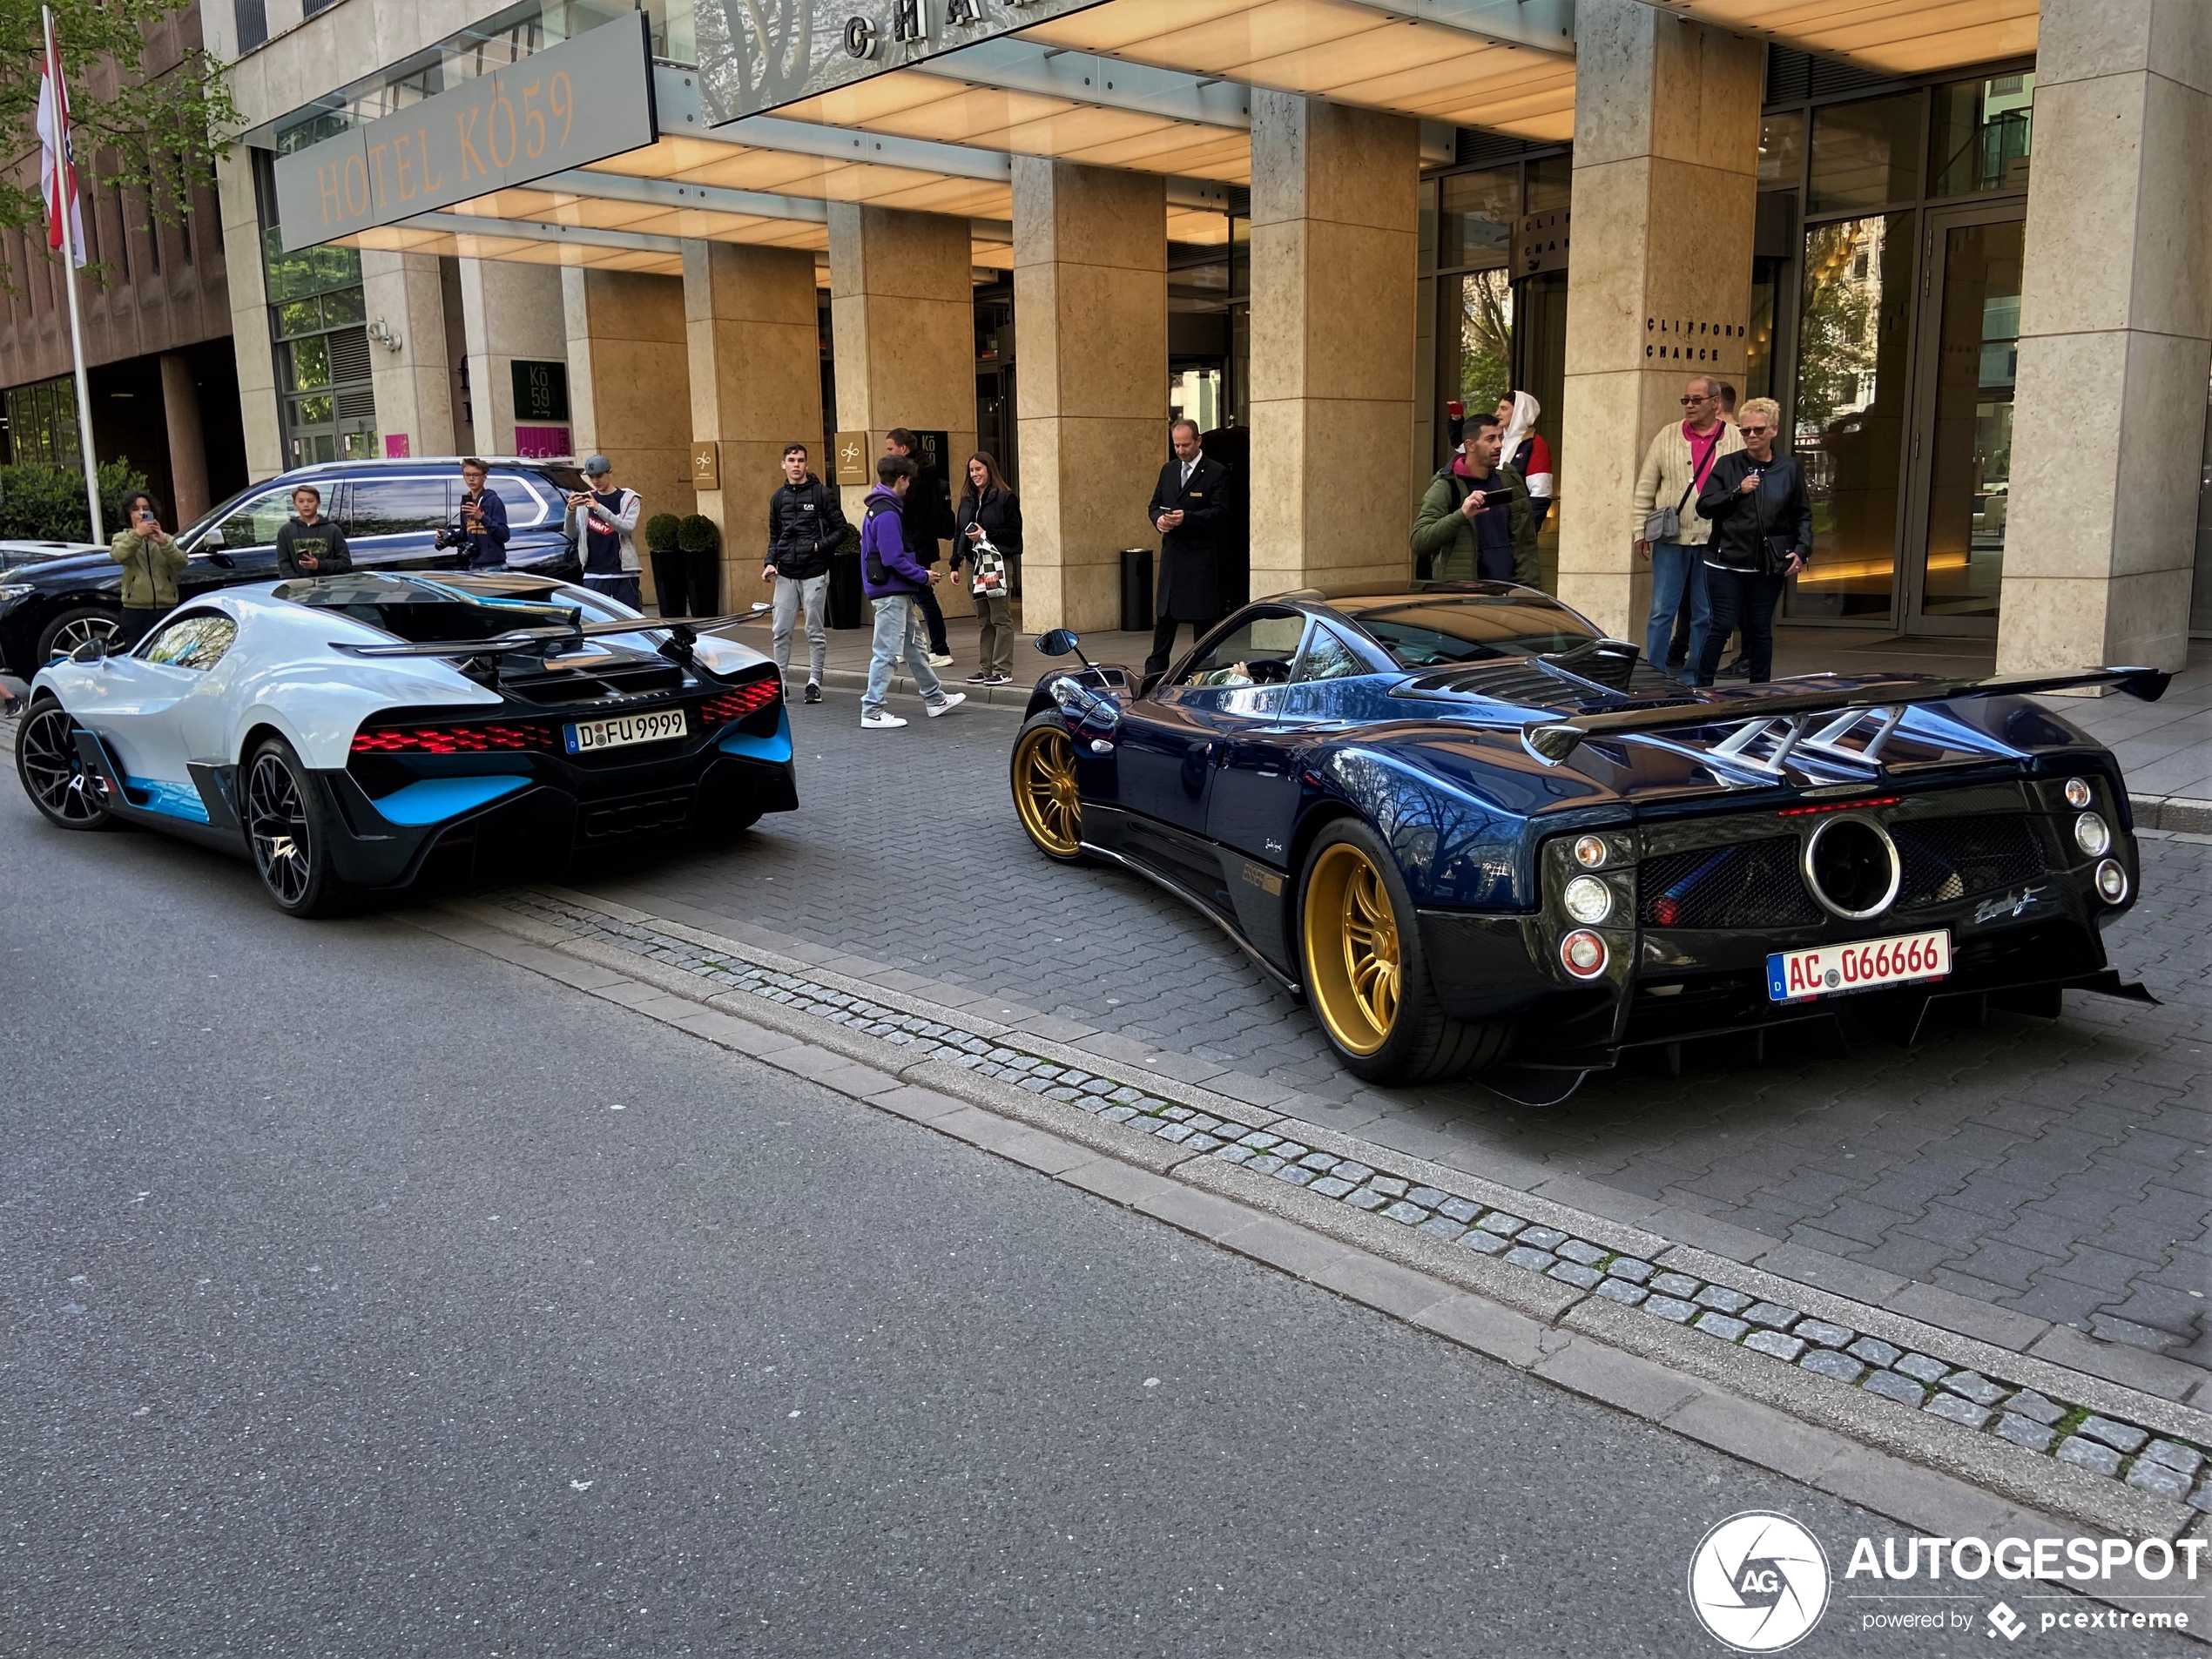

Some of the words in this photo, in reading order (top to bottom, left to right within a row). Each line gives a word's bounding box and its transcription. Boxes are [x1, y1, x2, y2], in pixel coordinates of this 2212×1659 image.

[317, 128, 442, 226] HOTEL
[455, 71, 574, 181] KÖ59
[1647, 318, 1744, 337] CLIFFORD
[1646, 345, 1718, 361] CHANCE
[530, 387, 550, 407] 59
[579, 725, 594, 747] D
[605, 719, 633, 743] FU
[636, 712, 683, 738] 9999
[1790, 954, 1823, 991] AC
[1841, 937, 1938, 982] 066666
[1774, 981, 1782, 992] D
